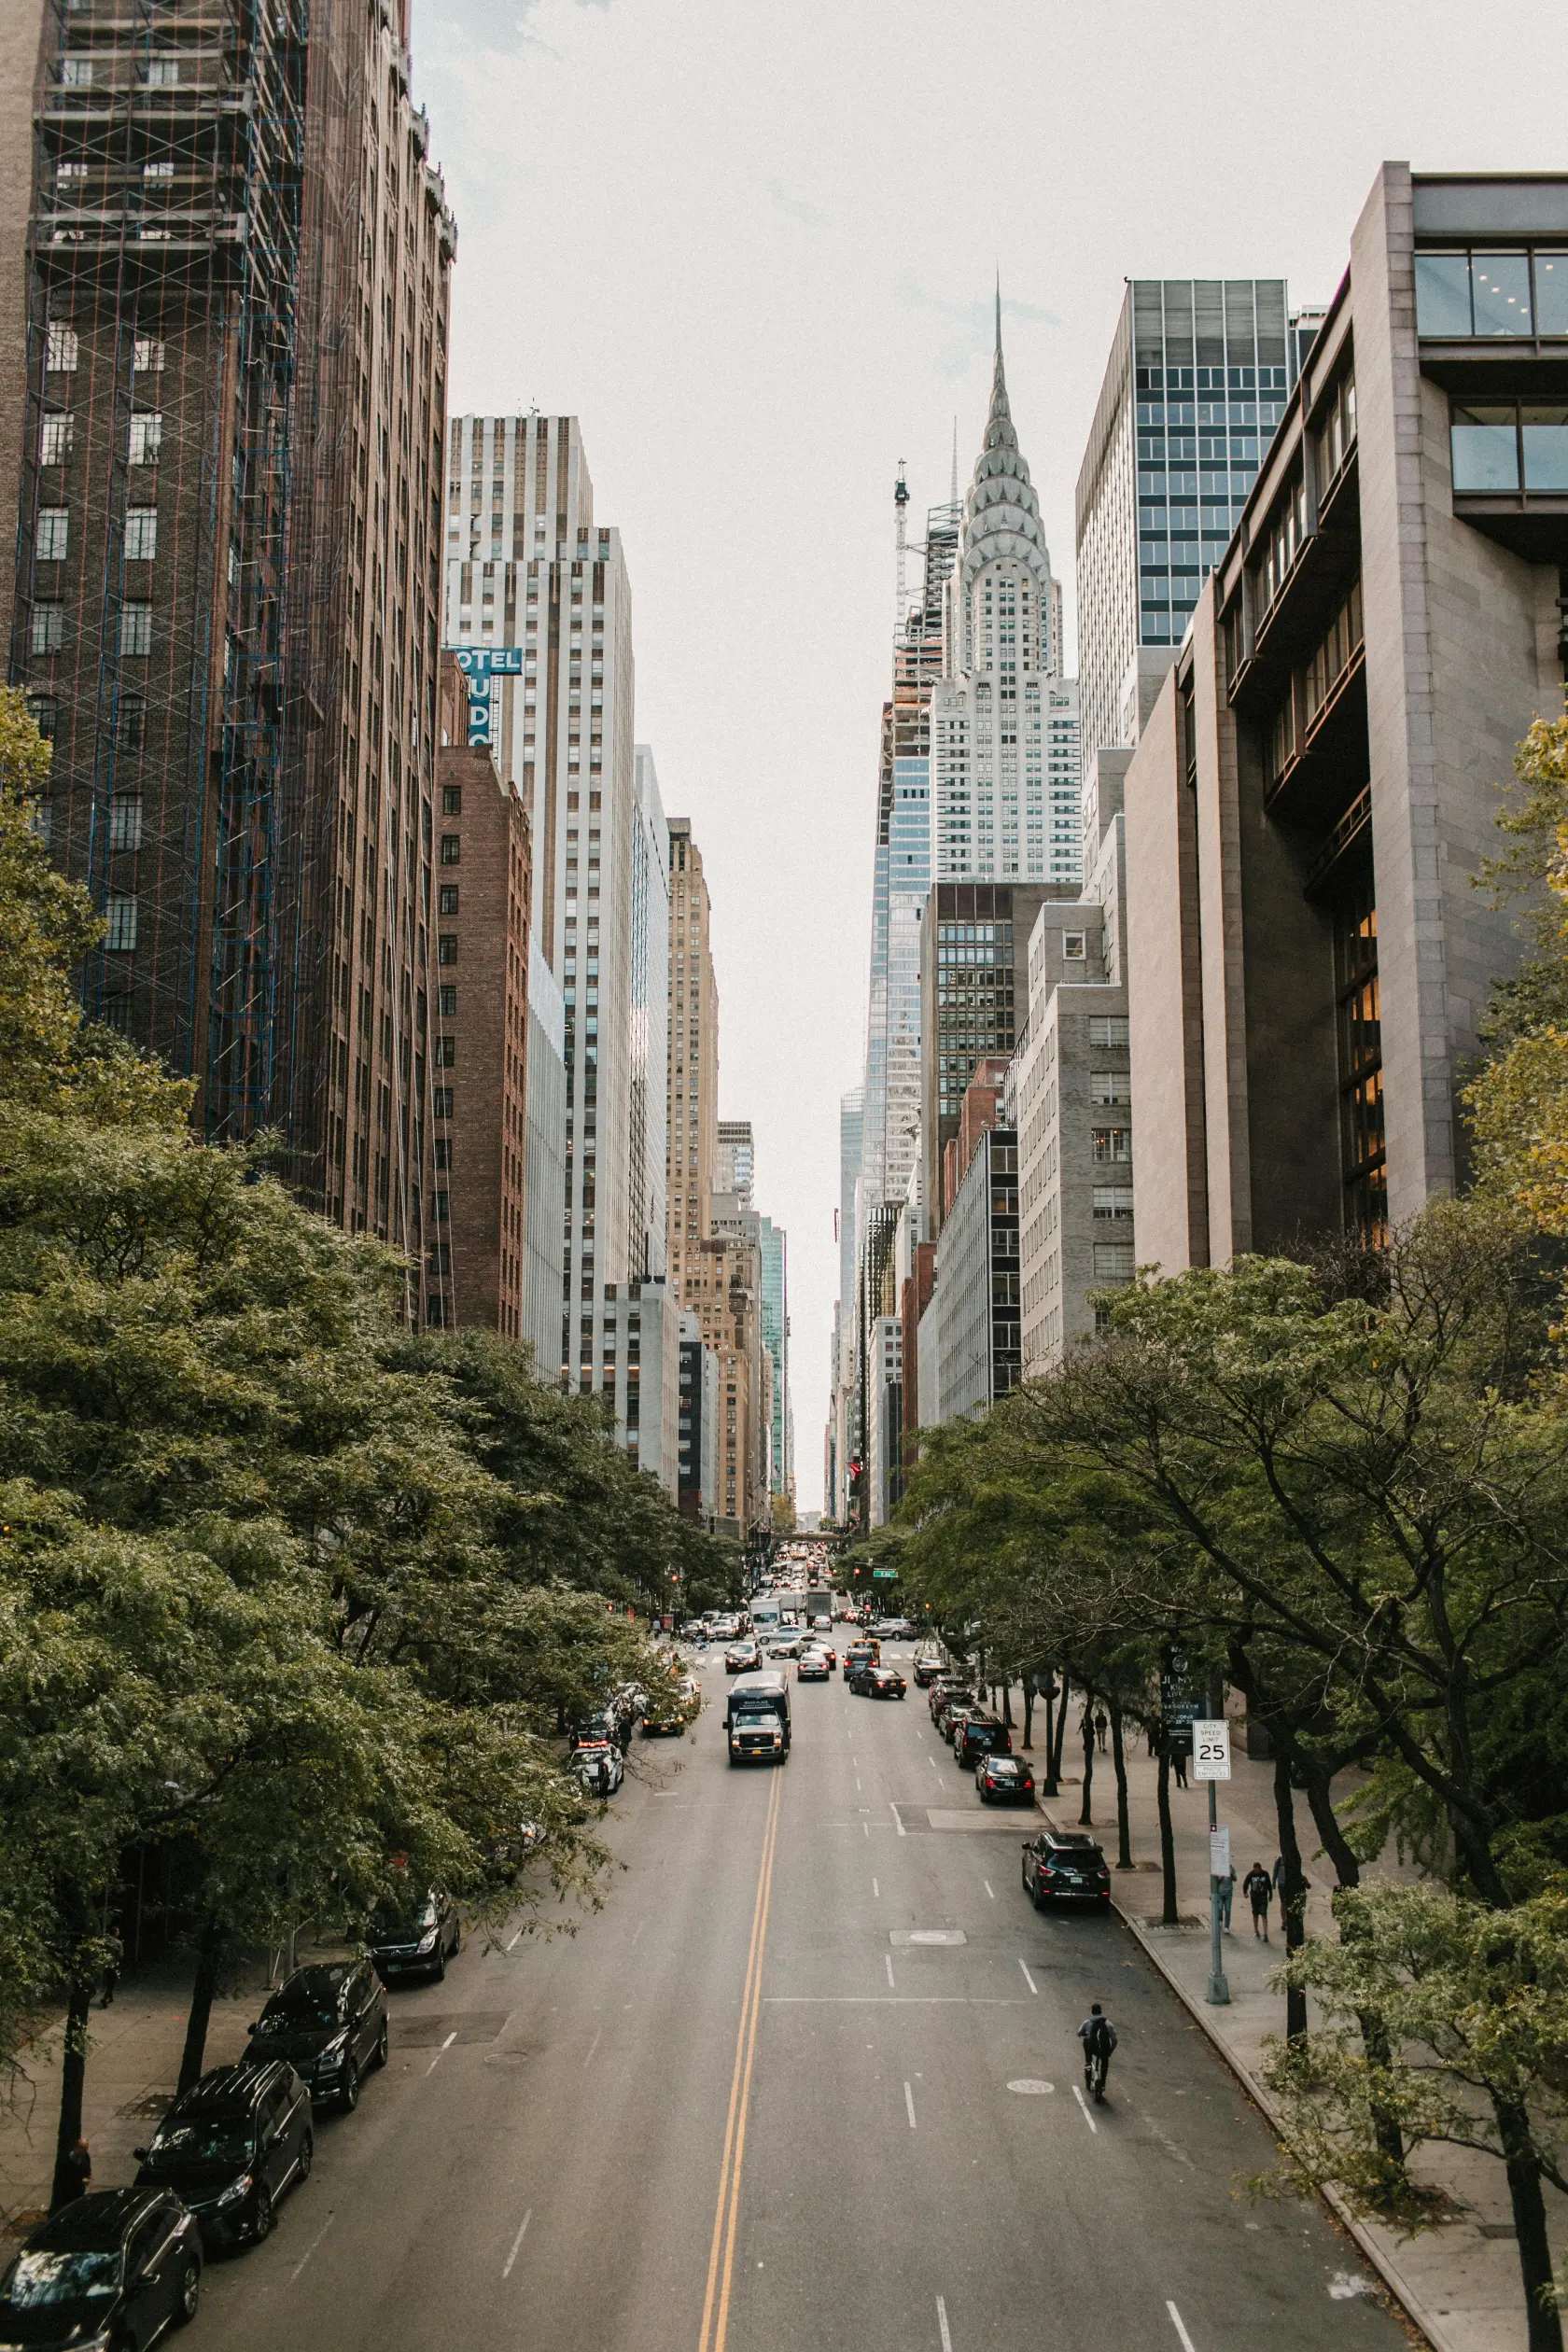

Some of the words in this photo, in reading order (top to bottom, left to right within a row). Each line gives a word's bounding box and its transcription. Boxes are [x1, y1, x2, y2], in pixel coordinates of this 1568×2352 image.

[456, 650, 520, 669] OTEL
[1162, 1675, 1193, 1684] JIMY
[1199, 1744, 1225, 1760] 25
